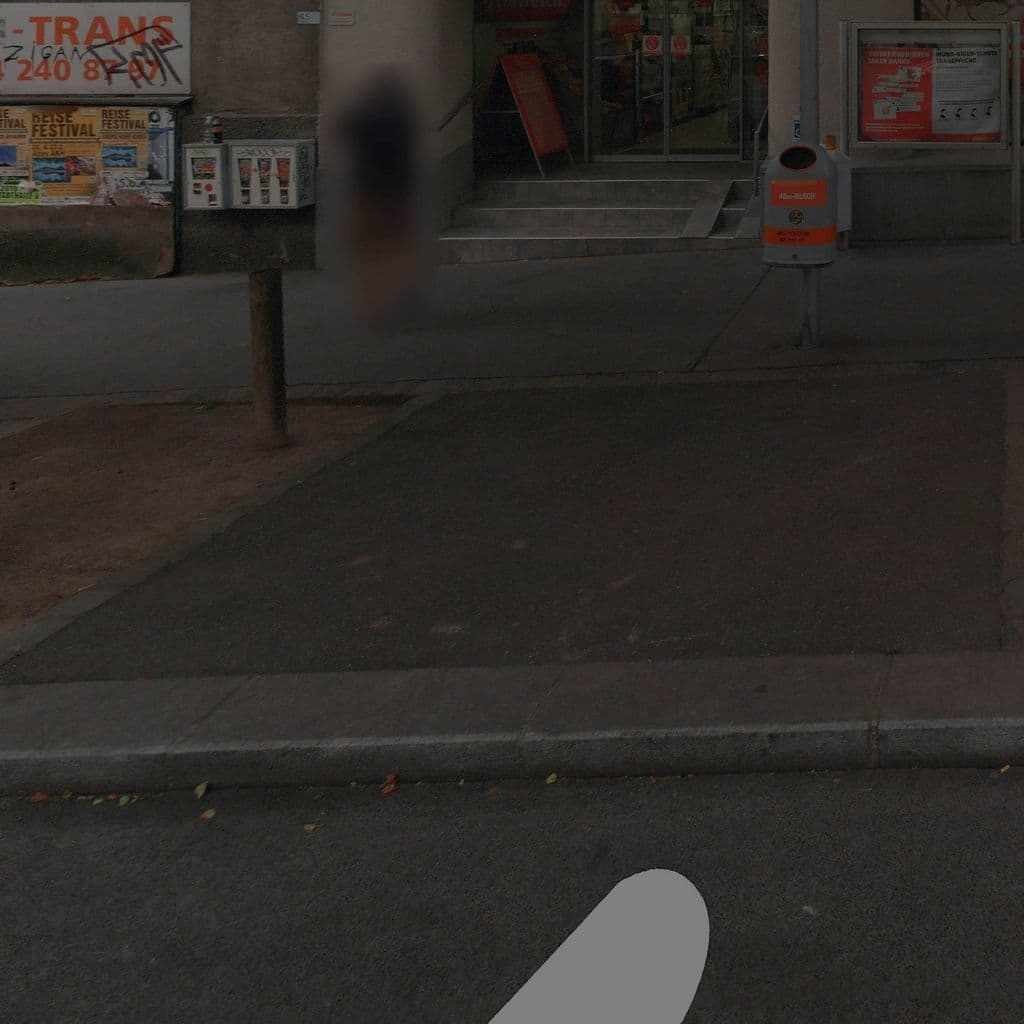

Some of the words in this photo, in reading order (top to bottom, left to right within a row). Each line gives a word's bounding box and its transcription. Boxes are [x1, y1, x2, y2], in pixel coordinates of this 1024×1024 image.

[17, 59, 71, 81] 240
[32, 111, 73, 123] REISE
[102, 109, 130, 119] REISE
[32, 123, 97, 137] FESTIVAL
[102, 119, 146, 130] FESTIVAL
